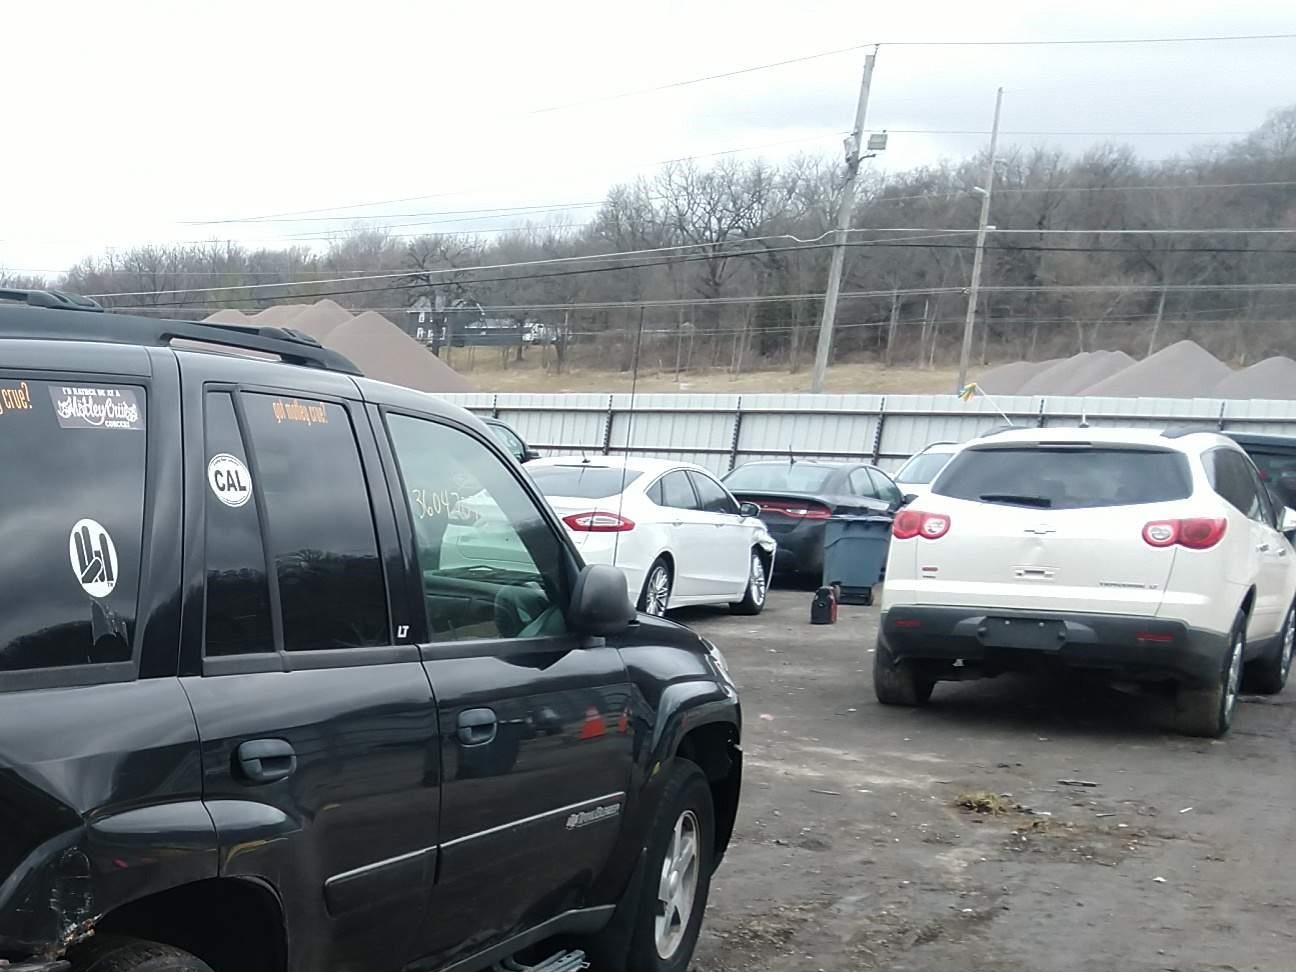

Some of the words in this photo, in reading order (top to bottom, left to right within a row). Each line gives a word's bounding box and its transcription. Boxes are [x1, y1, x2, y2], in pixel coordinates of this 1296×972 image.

[1, 381, 33, 409] crue?
[214, 469, 247, 492] CAL
[398, 625, 410, 638] LT
